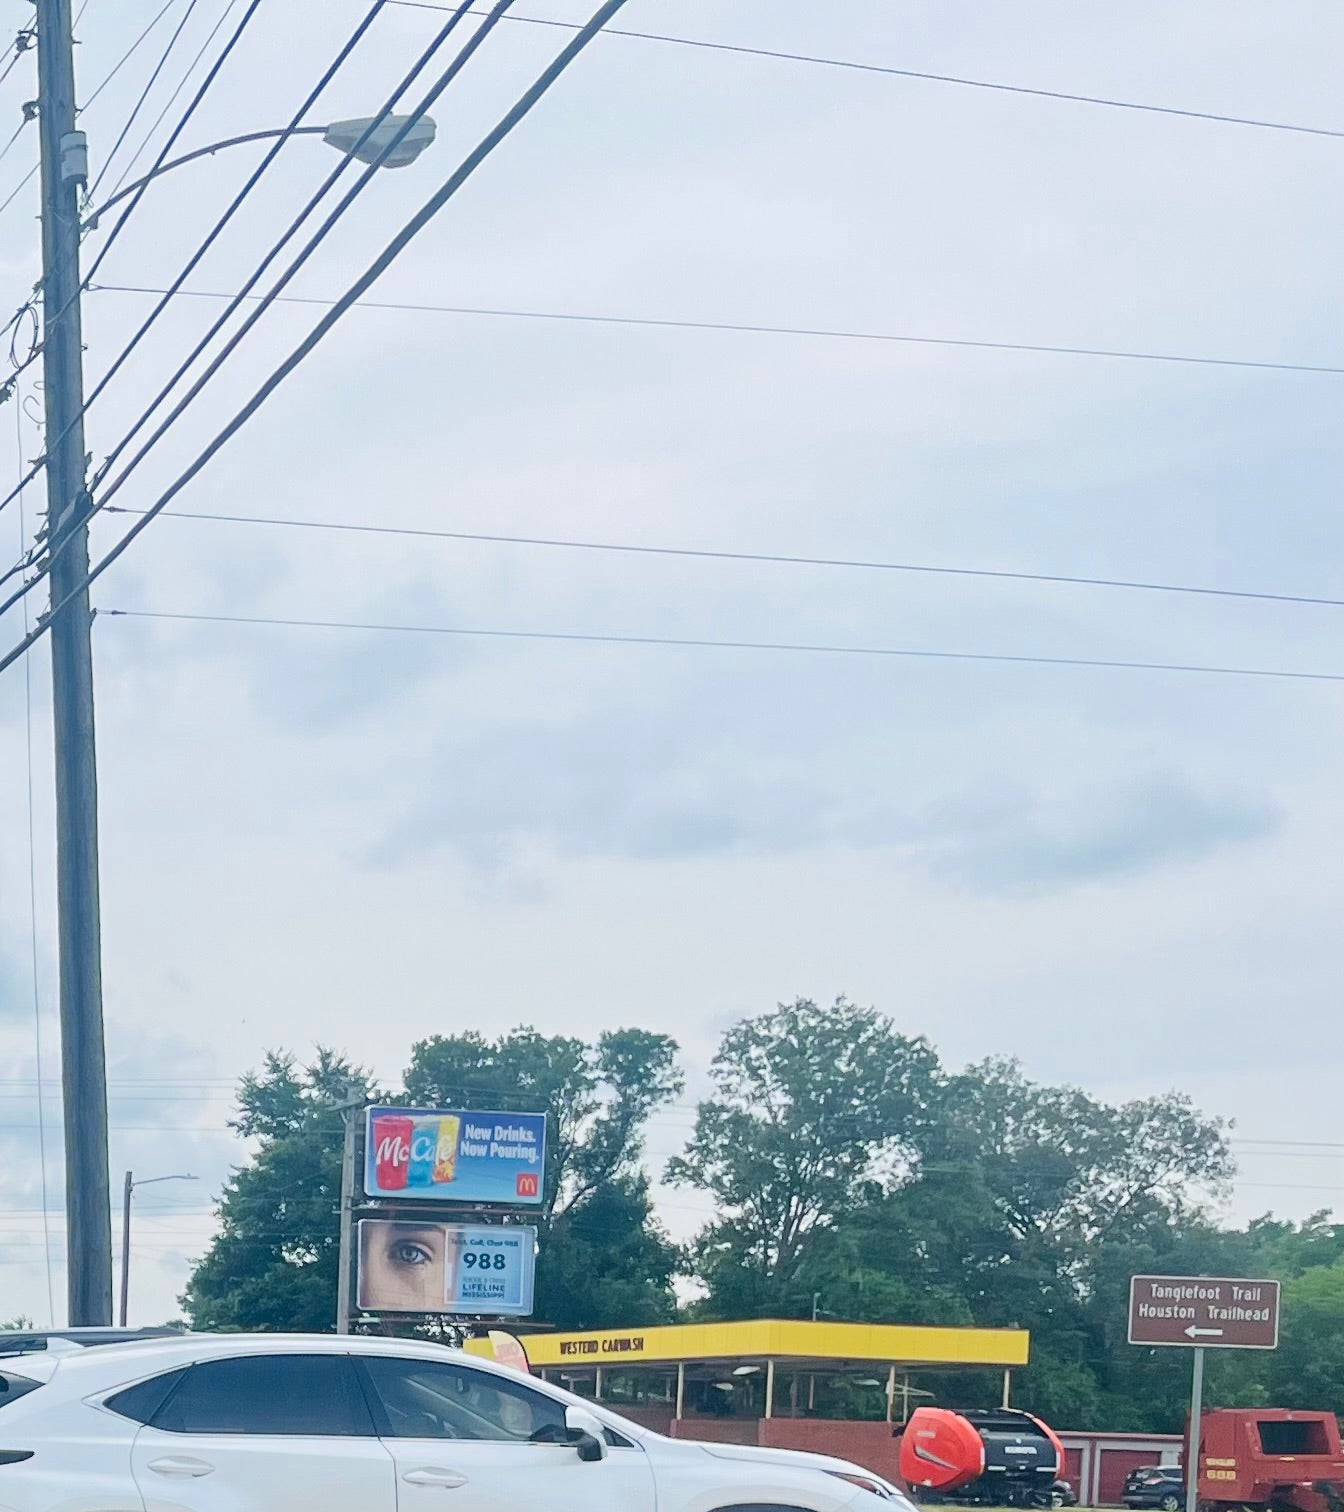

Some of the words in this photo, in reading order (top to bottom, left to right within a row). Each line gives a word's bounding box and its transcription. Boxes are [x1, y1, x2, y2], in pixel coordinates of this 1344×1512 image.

[464, 1124, 491, 1140] New
[493, 1125, 537, 1143] Drinks.
[460, 1141, 488, 1157] Now
[489, 1142, 540, 1164] Pouring.
[463, 1252, 506, 1270] 988
[462, 1283, 505, 1291] LIFELINE
[1150, 1284, 1220, 1302] Tanglefoot
[1232, 1286, 1261, 1301] Trail
[1139, 1304, 1195, 1319] Houston
[1207, 1305, 1269, 1321] Trailhead
